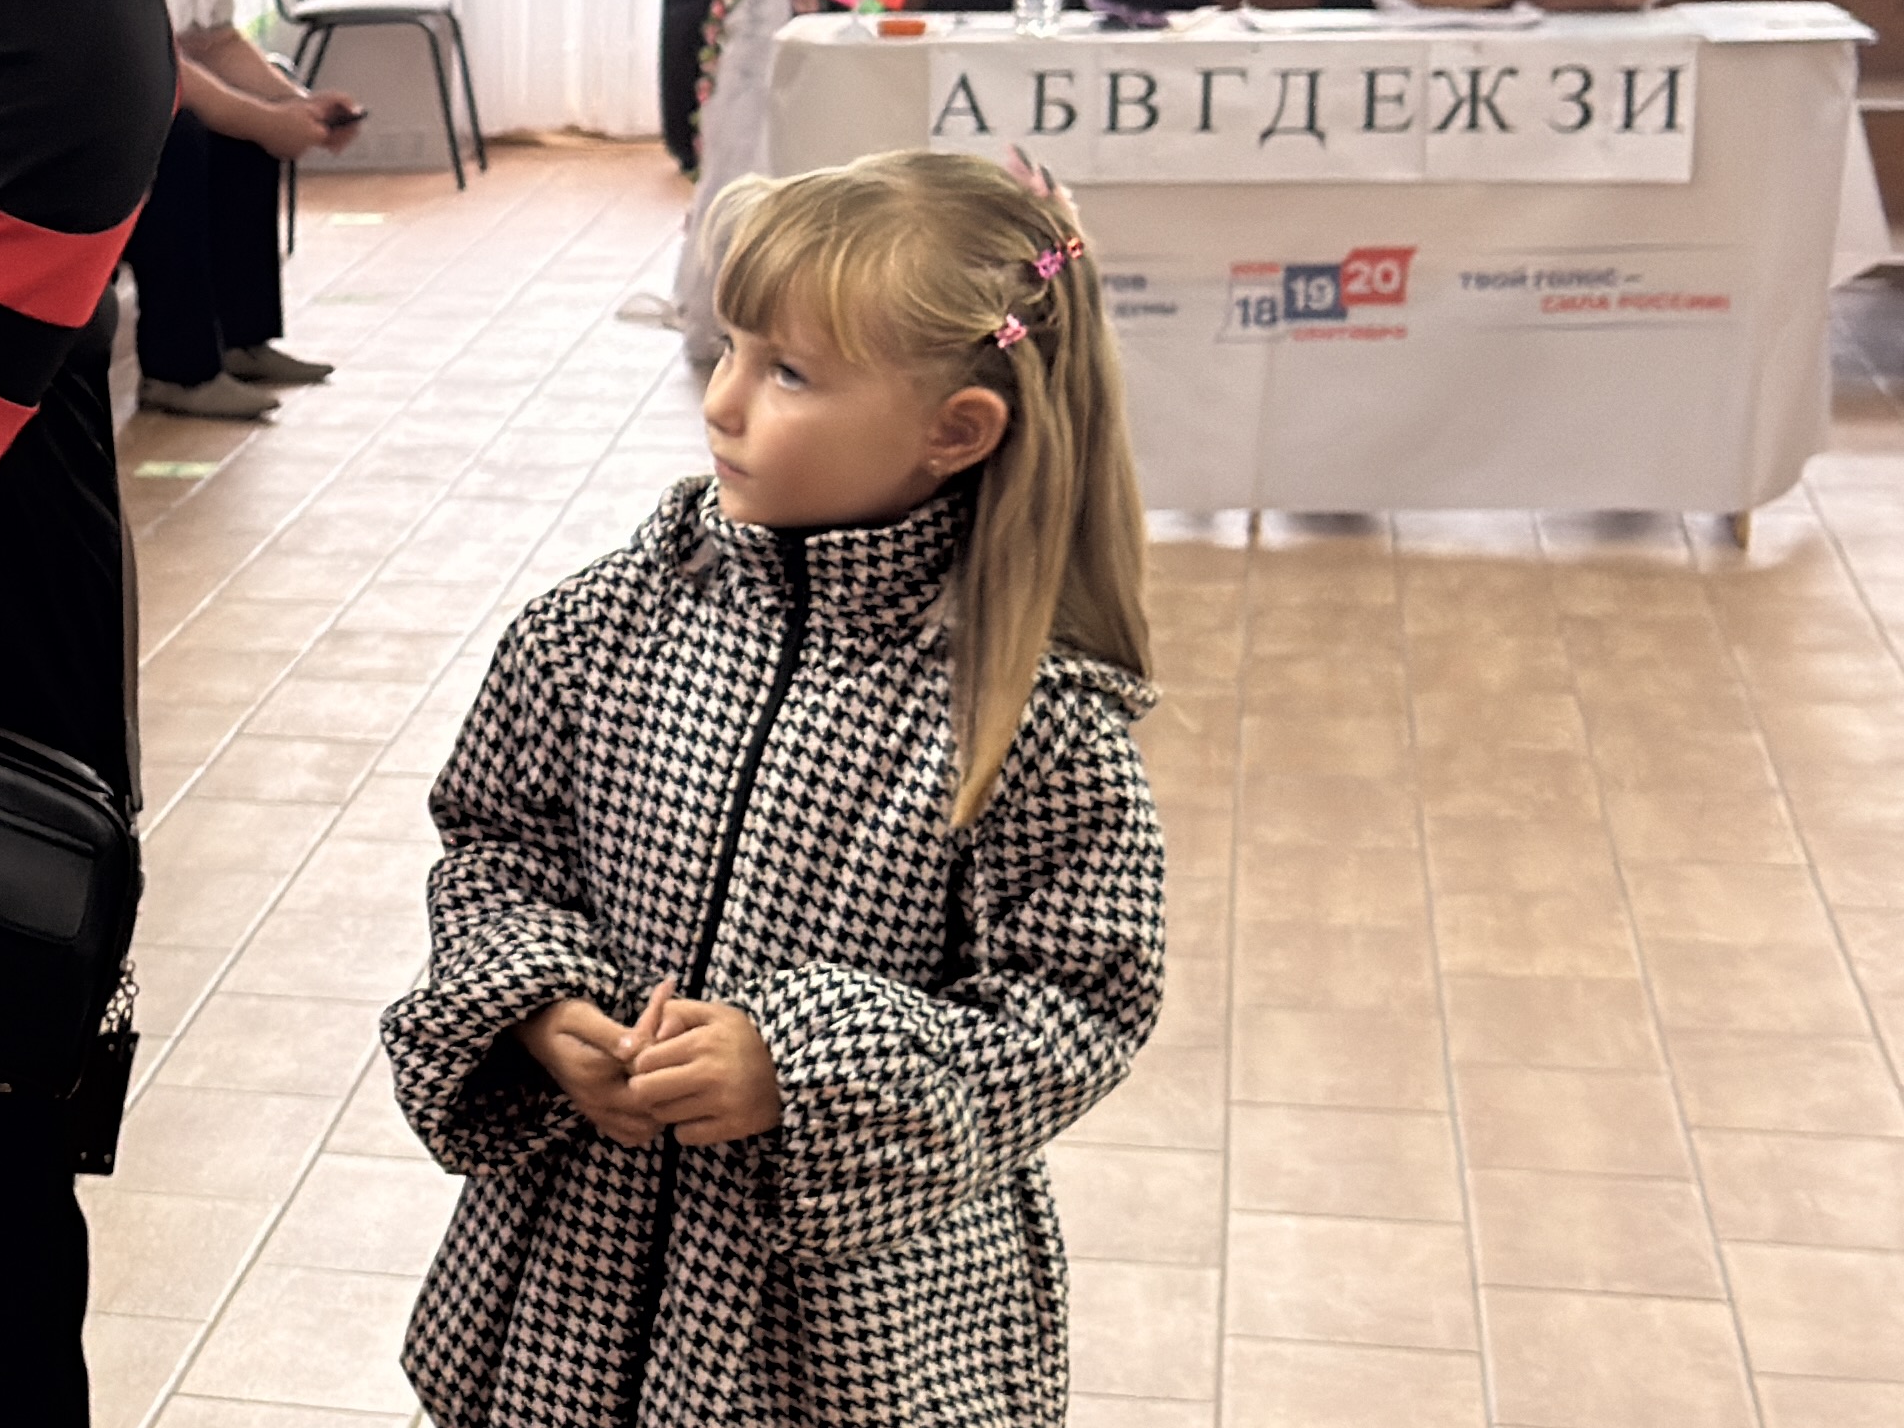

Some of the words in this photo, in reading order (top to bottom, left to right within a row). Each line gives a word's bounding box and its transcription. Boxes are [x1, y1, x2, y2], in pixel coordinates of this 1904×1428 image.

[1235, 295, 1278, 328] 18
[1289, 274, 1337, 312] 19
[1344, 260, 1402, 295] 20
